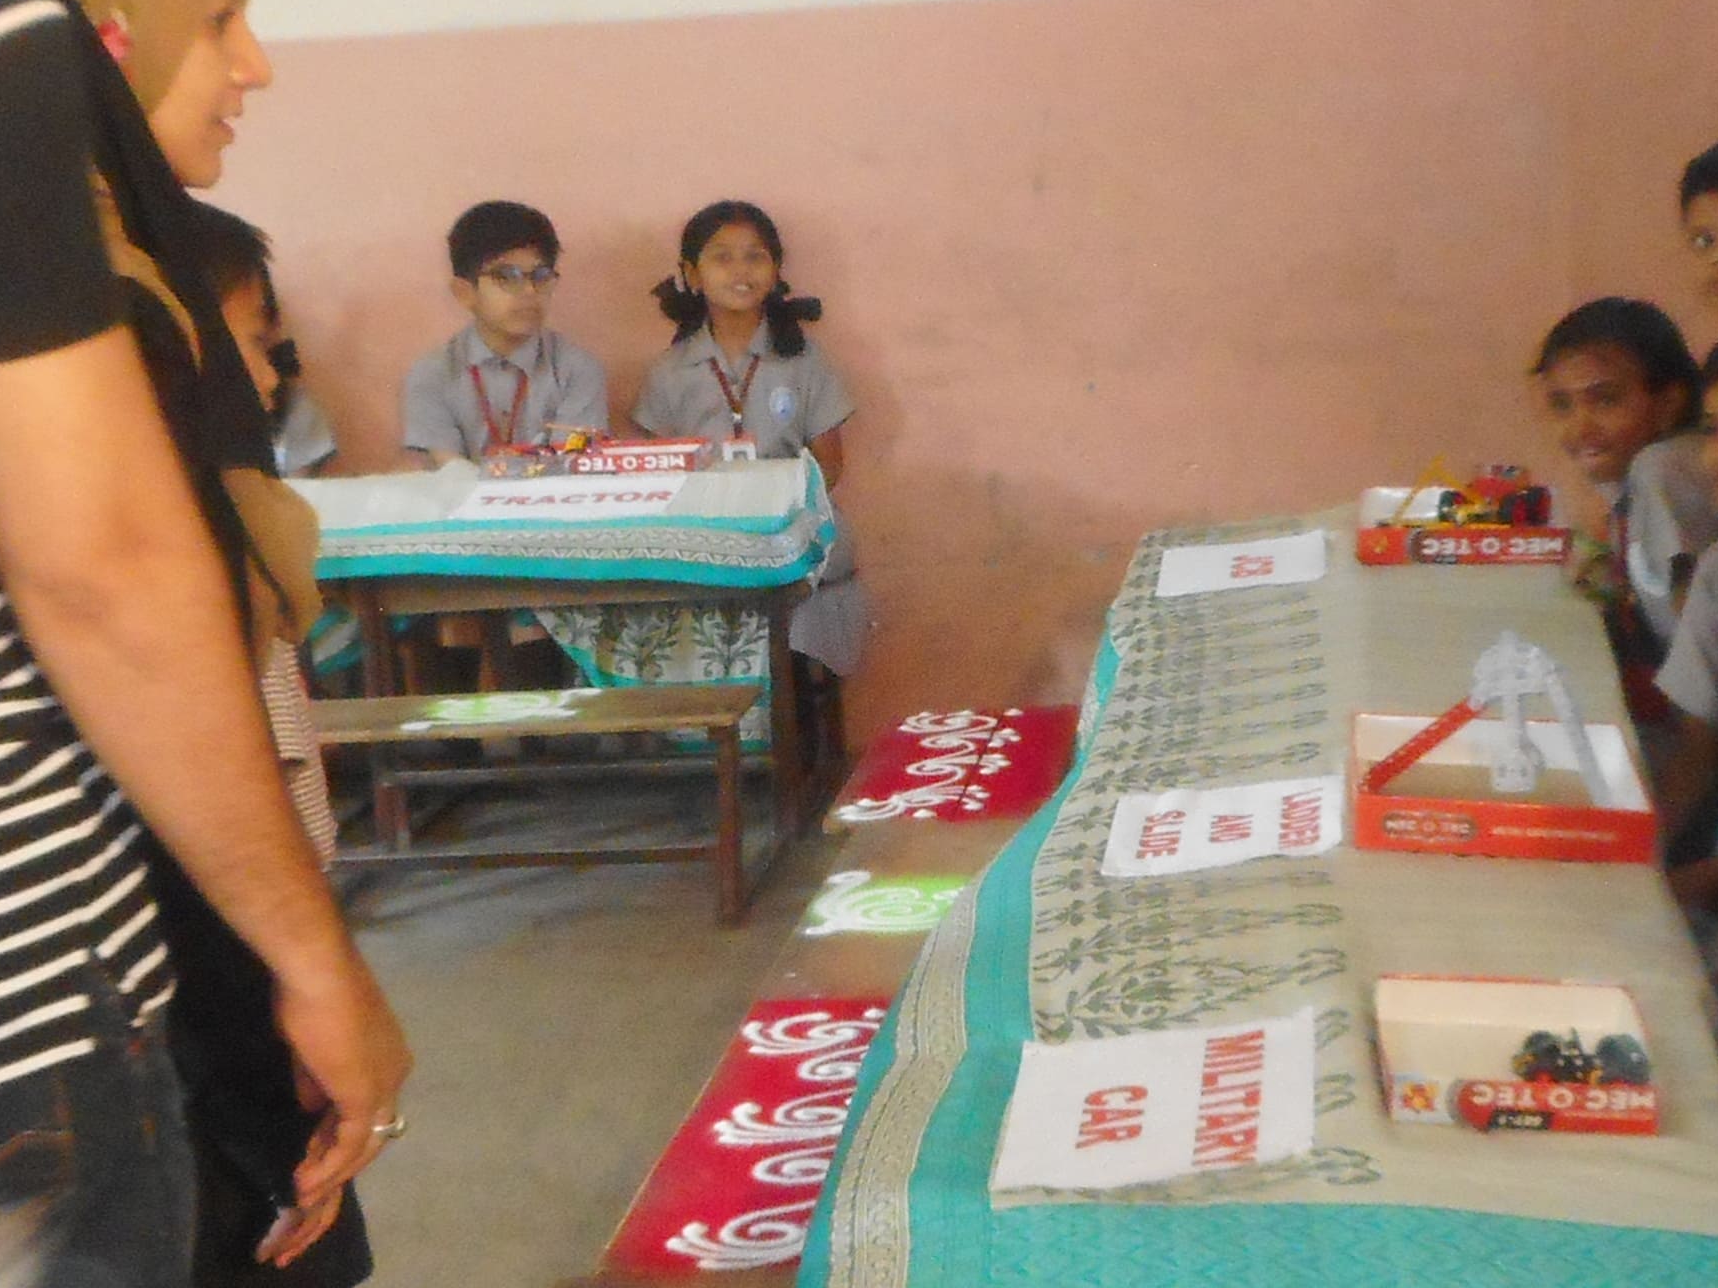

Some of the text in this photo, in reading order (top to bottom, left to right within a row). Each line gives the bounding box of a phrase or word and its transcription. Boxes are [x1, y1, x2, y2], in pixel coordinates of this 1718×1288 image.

[480, 491, 673, 505] TRACTOR
[1230, 555, 1275, 579] JCB
[1135, 810, 1187, 859] SLIDE
[1209, 813, 1255, 843] AND
[1279, 787, 1324, 850] LADDER
[1074, 1085, 1150, 1149] CAR
[1191, 1028, 1266, 1166] MILITARY
